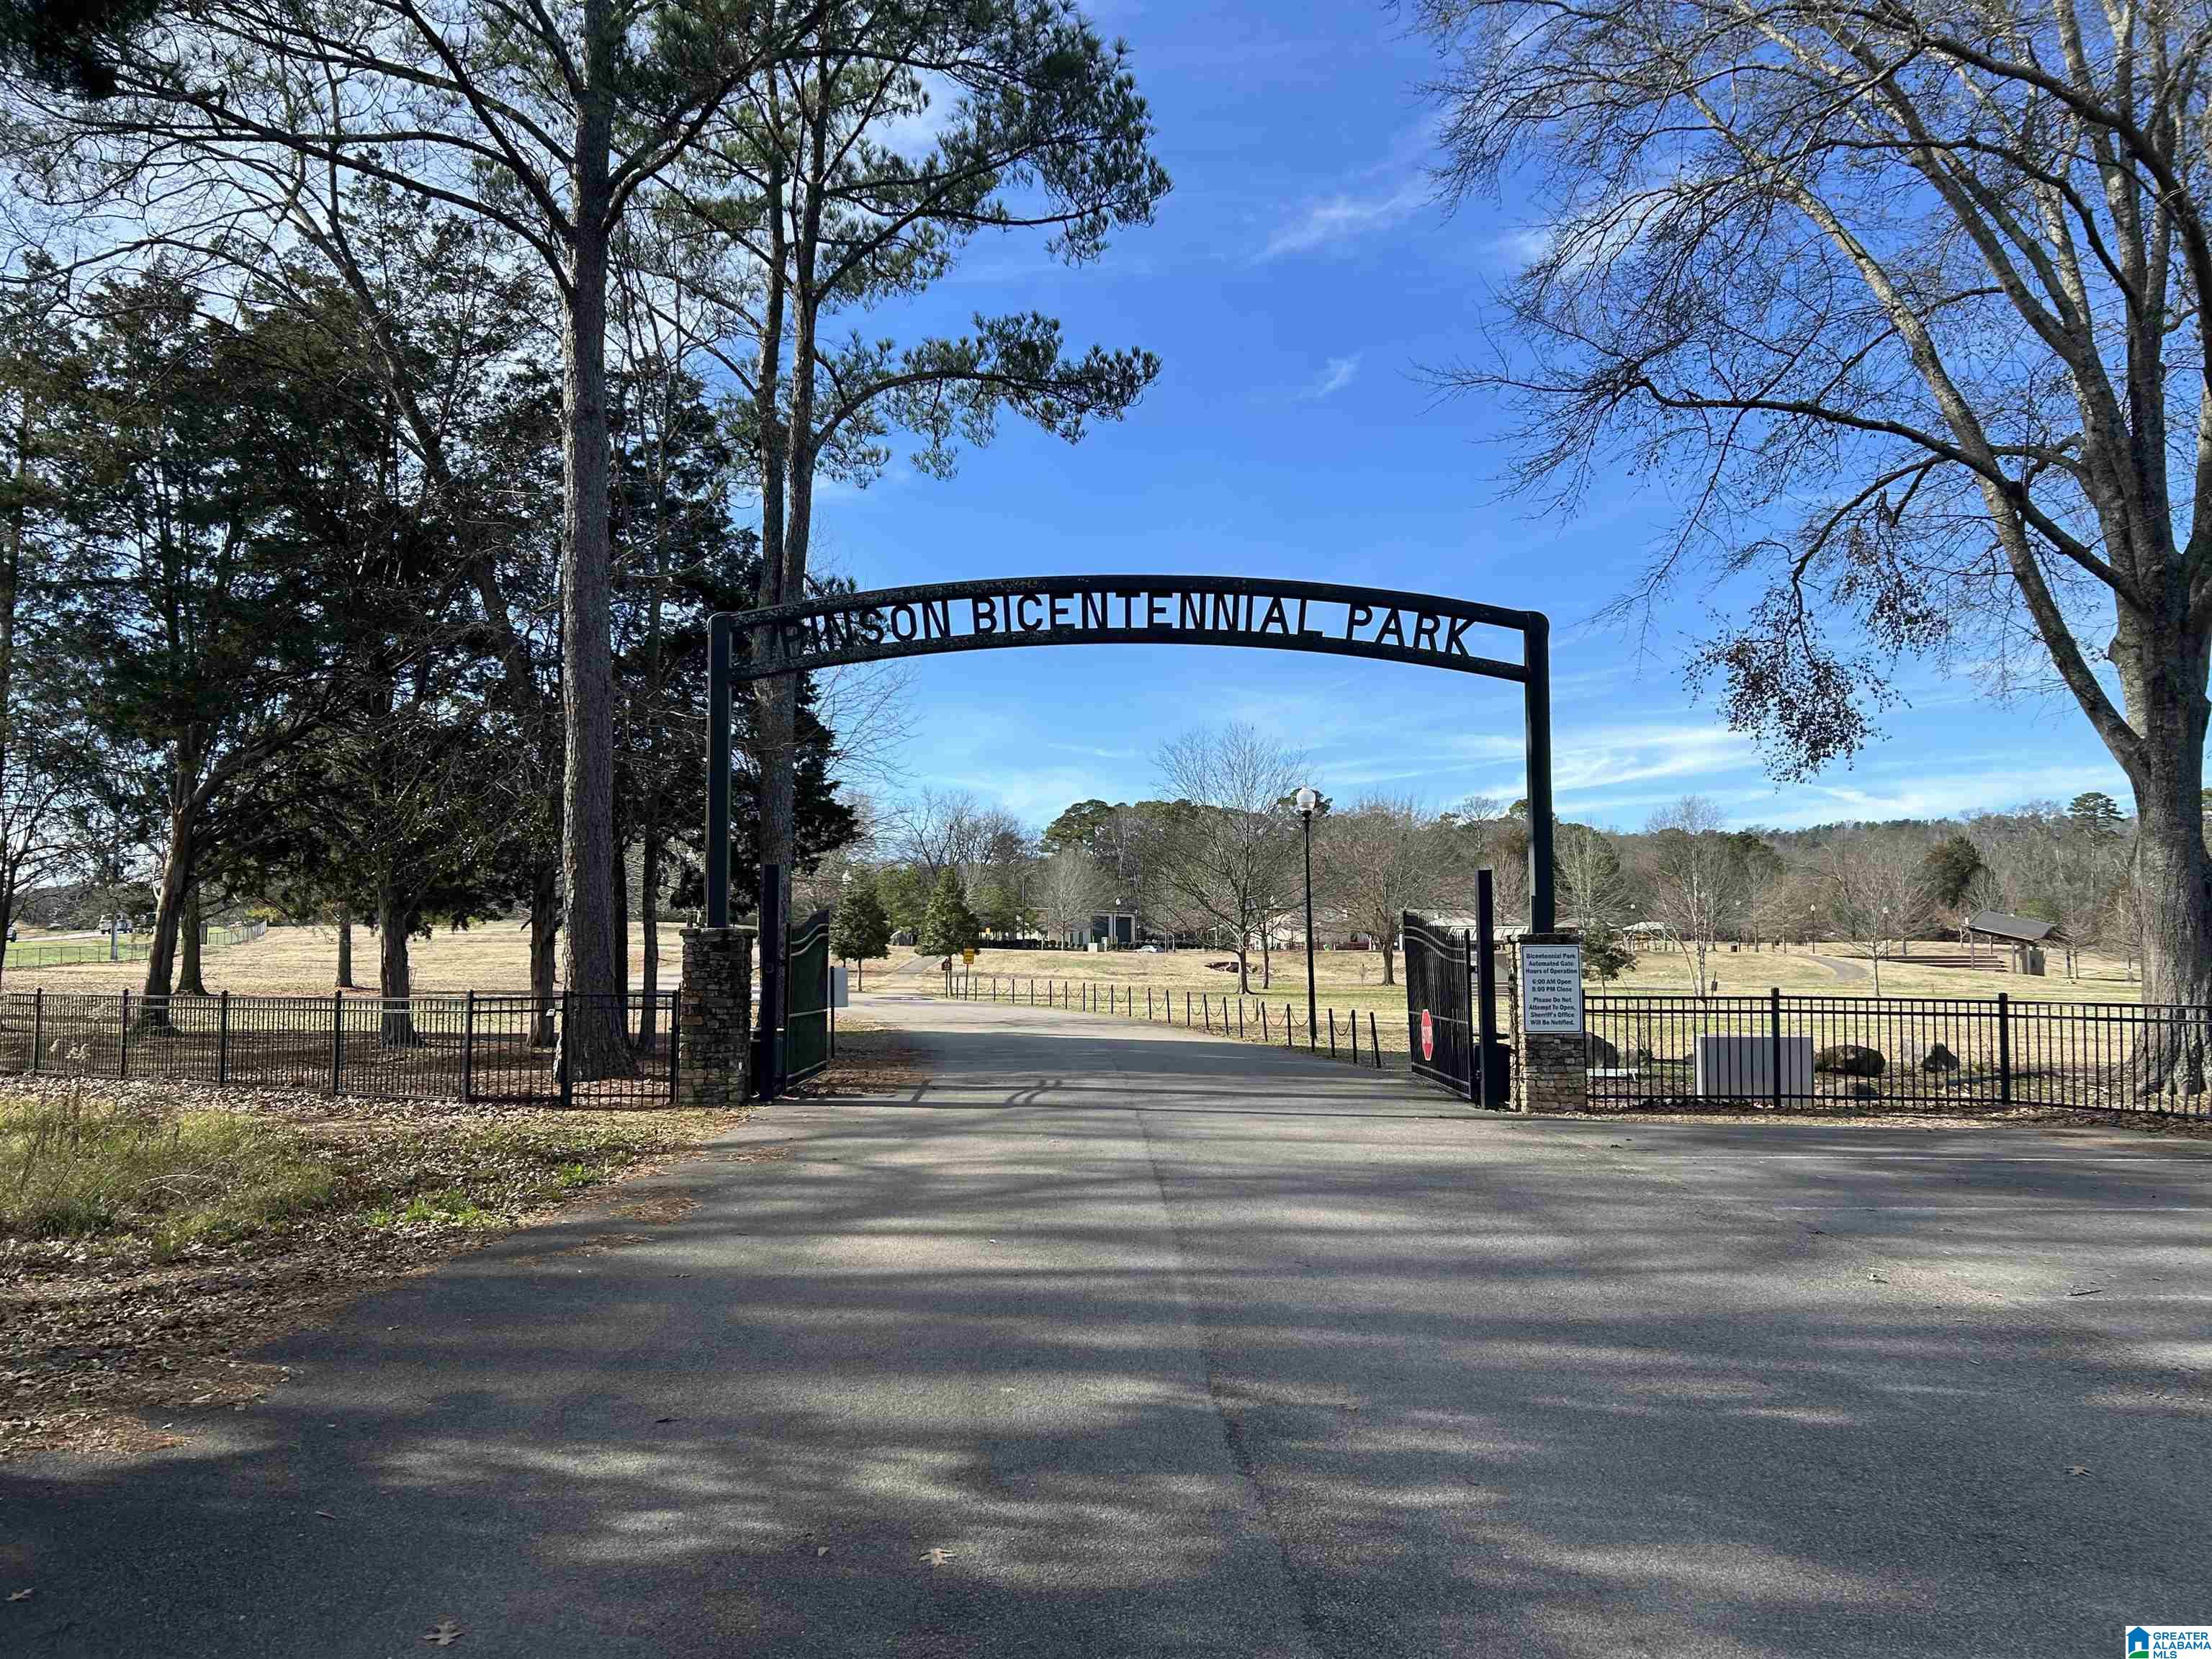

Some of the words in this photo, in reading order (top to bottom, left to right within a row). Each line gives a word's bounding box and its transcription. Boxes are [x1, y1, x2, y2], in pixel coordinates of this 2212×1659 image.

[778, 599, 951, 657] PINSON
[973, 591, 1323, 636] BICENTENNIAL
[1346, 603, 1475, 657] PARK
